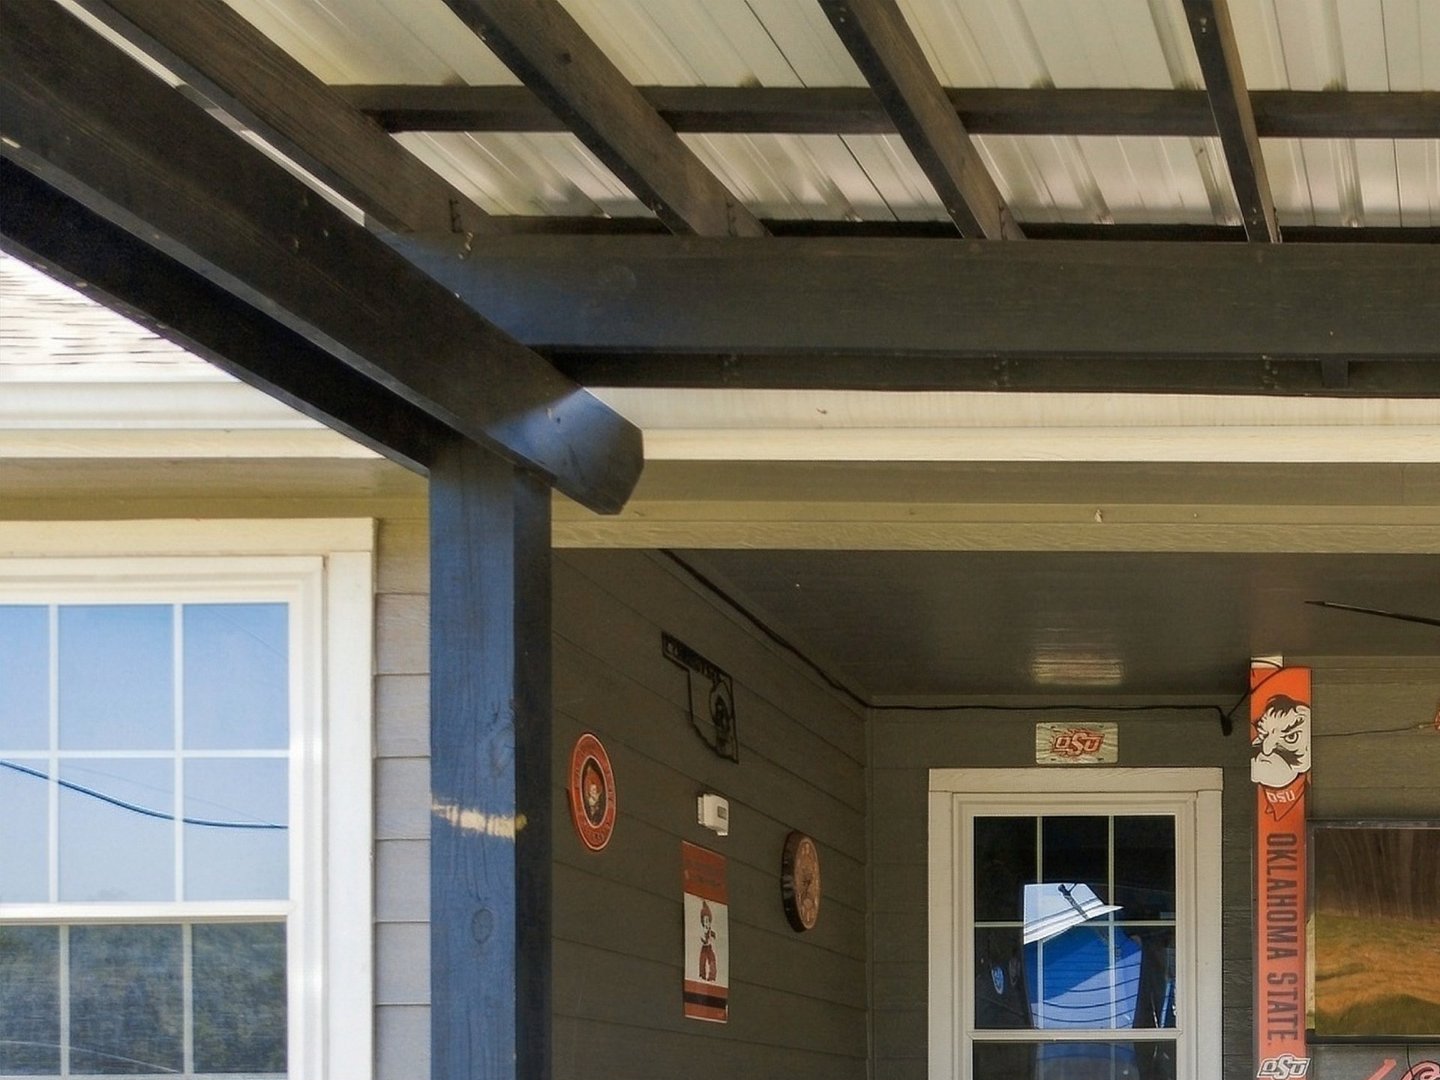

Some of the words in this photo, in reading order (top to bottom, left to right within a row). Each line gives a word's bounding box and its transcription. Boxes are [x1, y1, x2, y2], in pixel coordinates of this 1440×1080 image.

[1266, 790, 1296, 803] OSU
[1266, 833, 1298, 960] OKLAHOMA
[1267, 971, 1298, 1041] STATE
